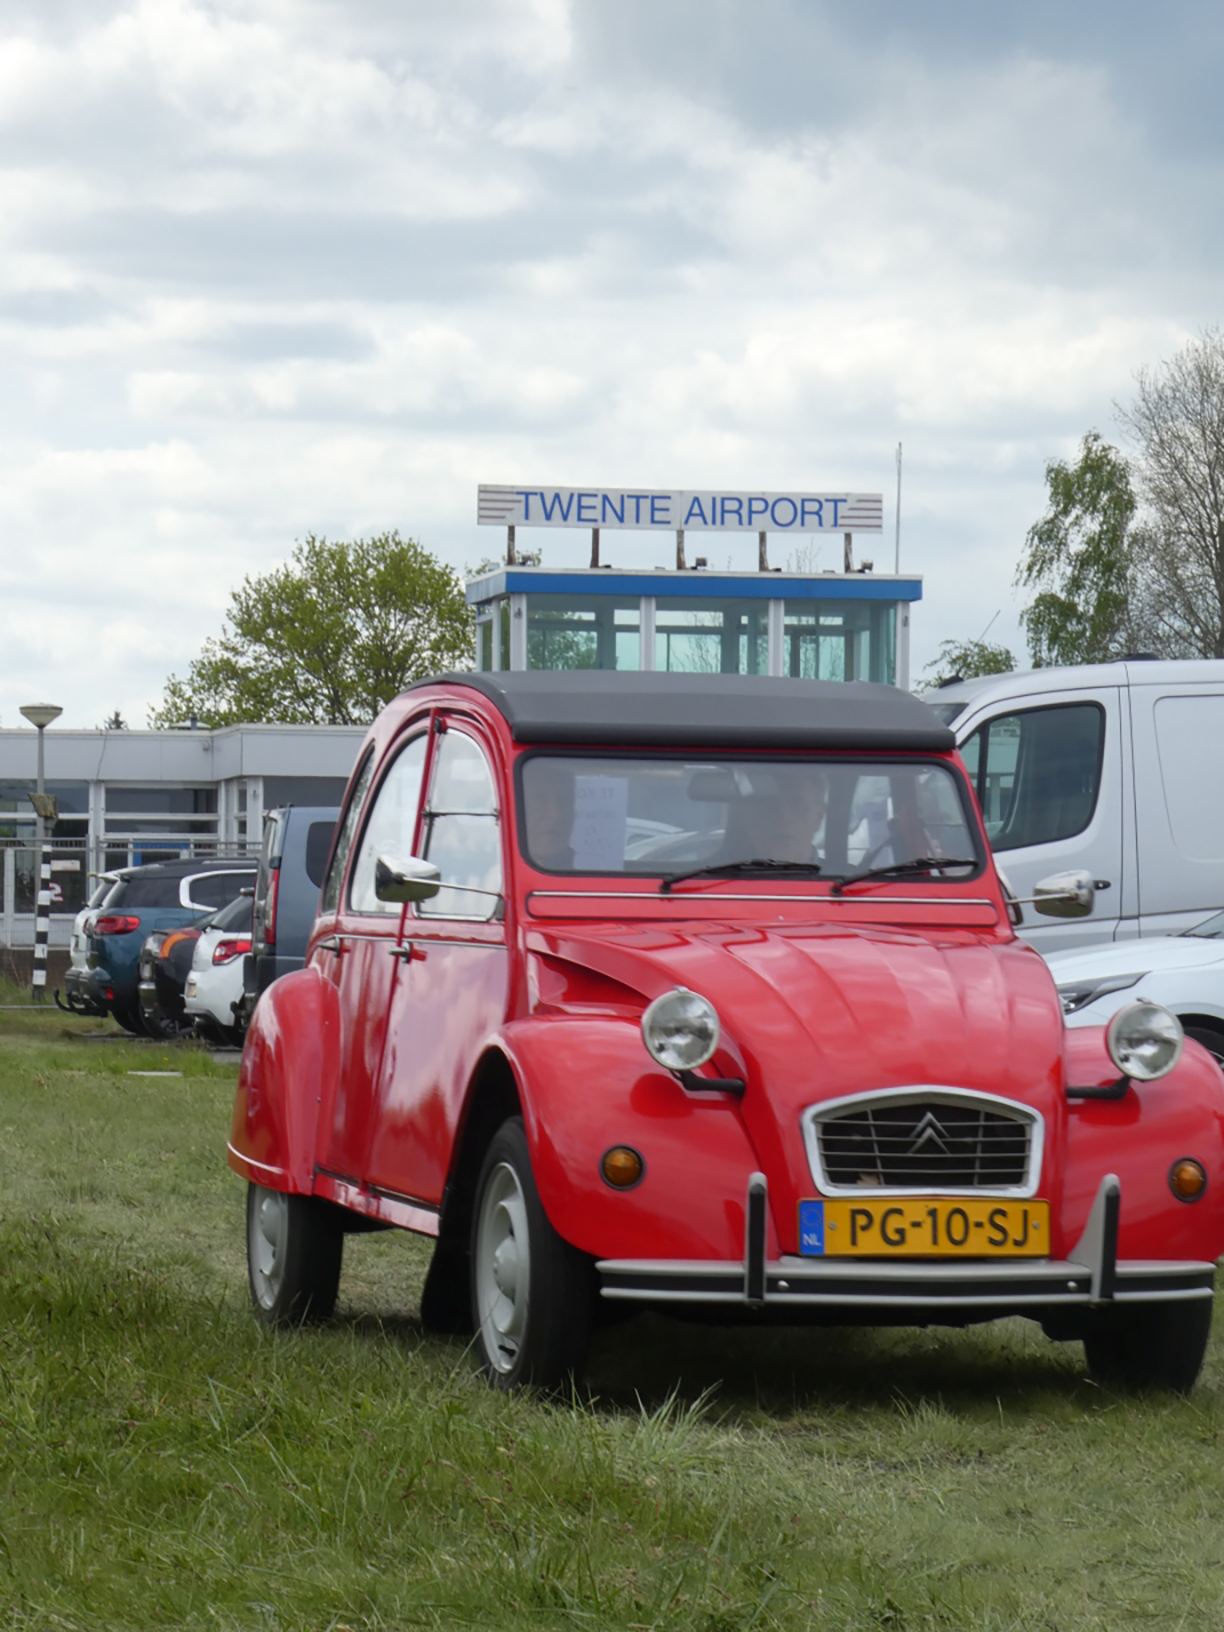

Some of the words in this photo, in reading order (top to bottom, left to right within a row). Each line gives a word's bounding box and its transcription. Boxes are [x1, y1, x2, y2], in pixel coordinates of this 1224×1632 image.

[516, 491, 672, 525] TWENTE
[684, 496, 848, 528] AIRPORT
[802, 1233, 822, 1247] NL
[850, 1208, 1029, 1246] PG-10-SJ
